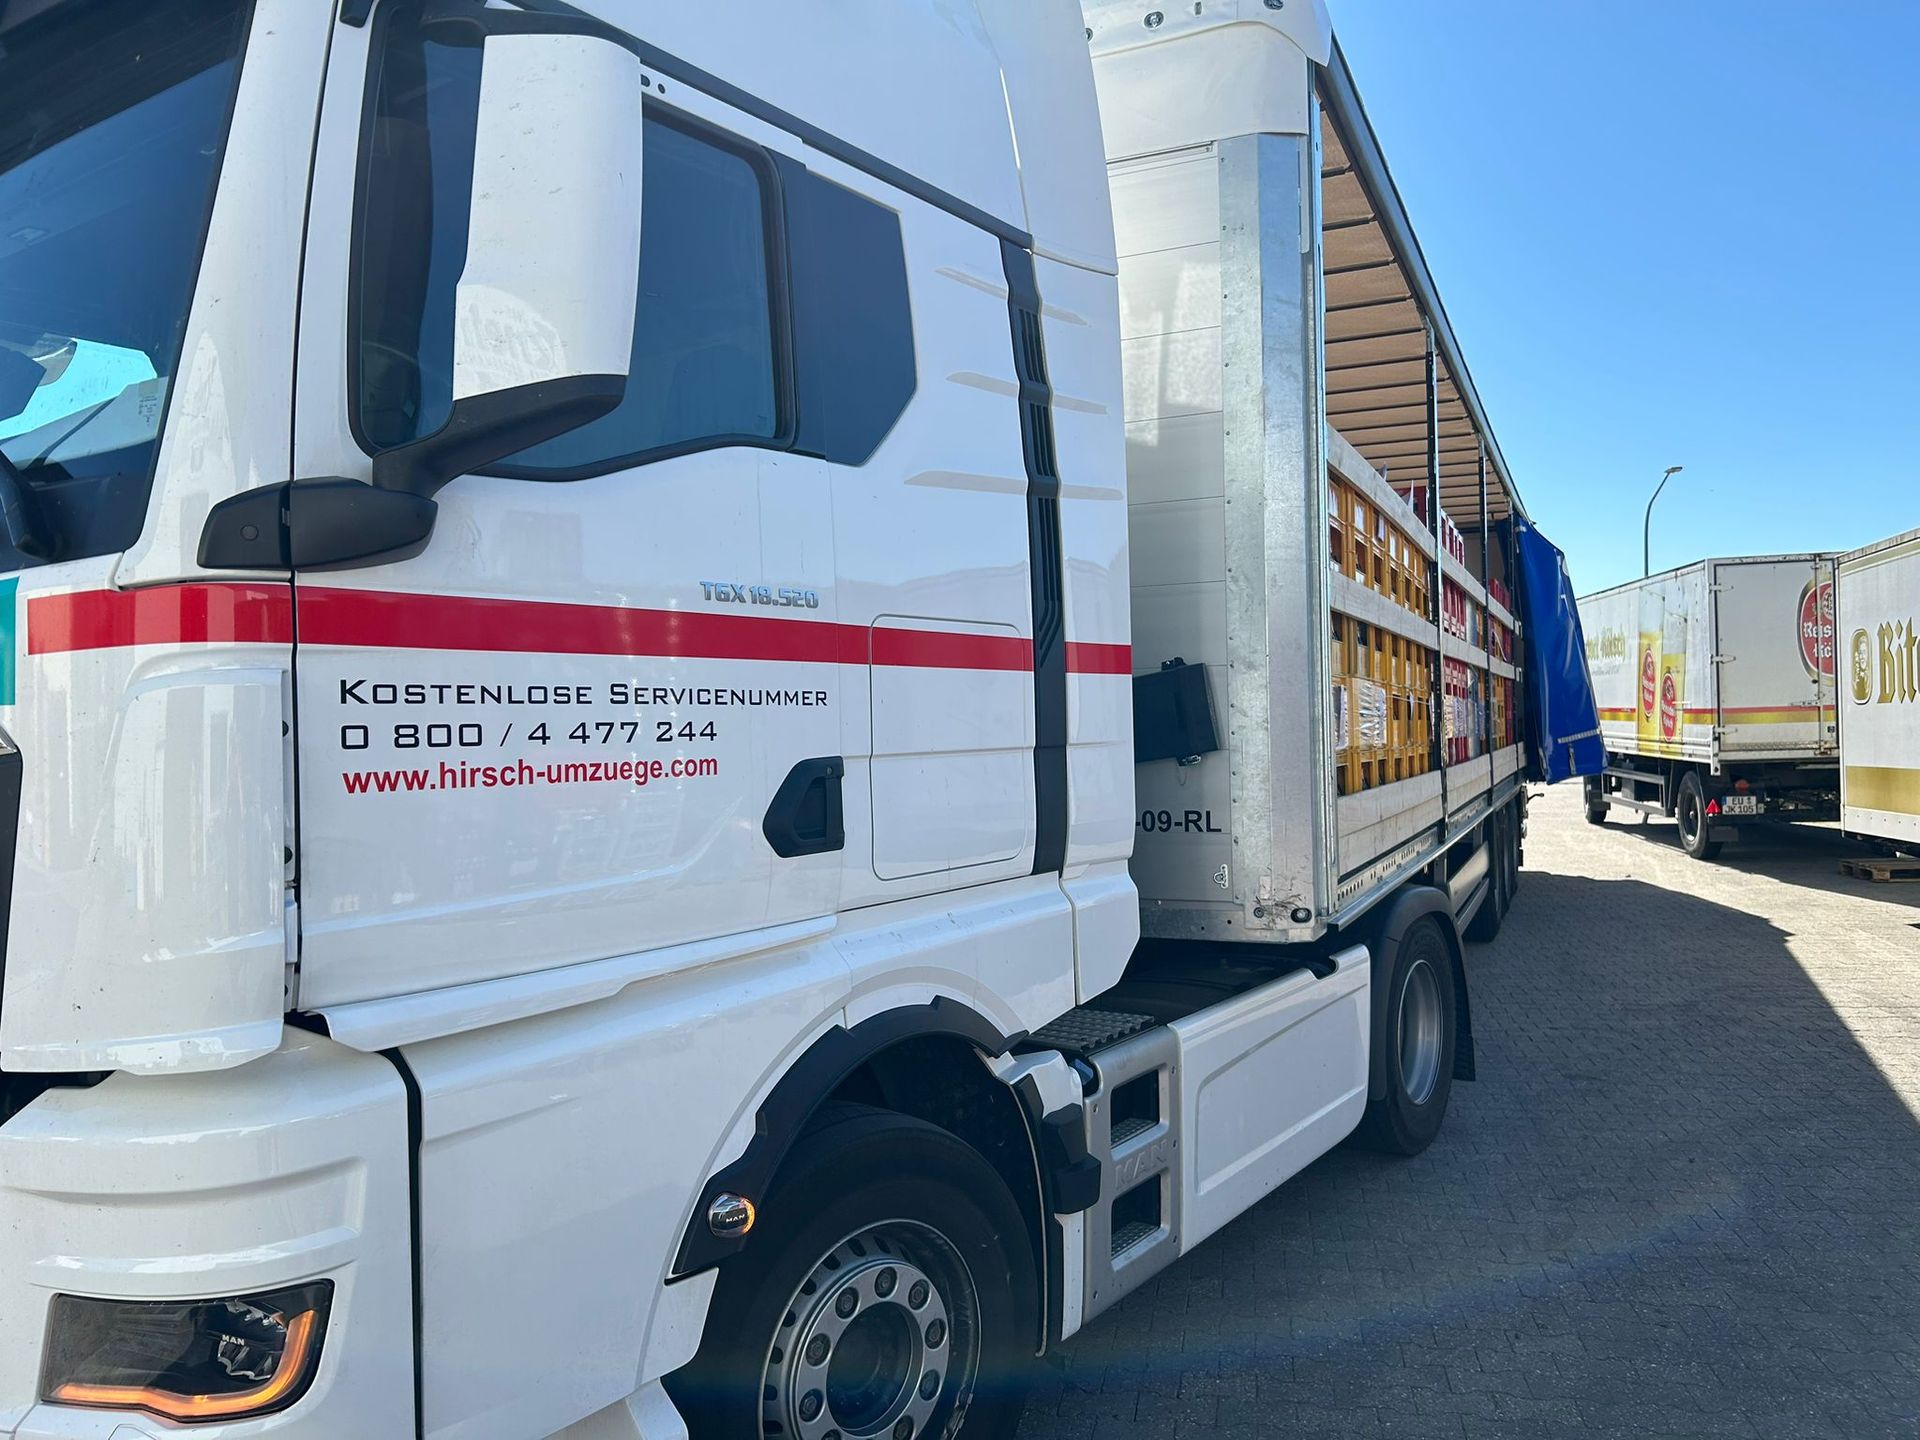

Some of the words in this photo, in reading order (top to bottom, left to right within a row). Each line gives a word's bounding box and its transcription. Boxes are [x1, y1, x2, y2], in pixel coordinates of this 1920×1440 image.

[700, 580, 747, 604] TGX
[749, 585, 819, 609] 18.520
[1877, 616, 1920, 704] Bit
[341, 724, 369, 750] 0
[393, 723, 483, 749] 800
[499, 722, 513, 748] /
[527, 722, 551, 746] 4
[568, 721, 639, 745] 477
[656, 720, 718, 743] 244
[342, 757, 718, 794] www.hirsch-umzuege.com
[726, 1214, 745, 1222] MAN
[221, 1334, 245, 1346] MAN
